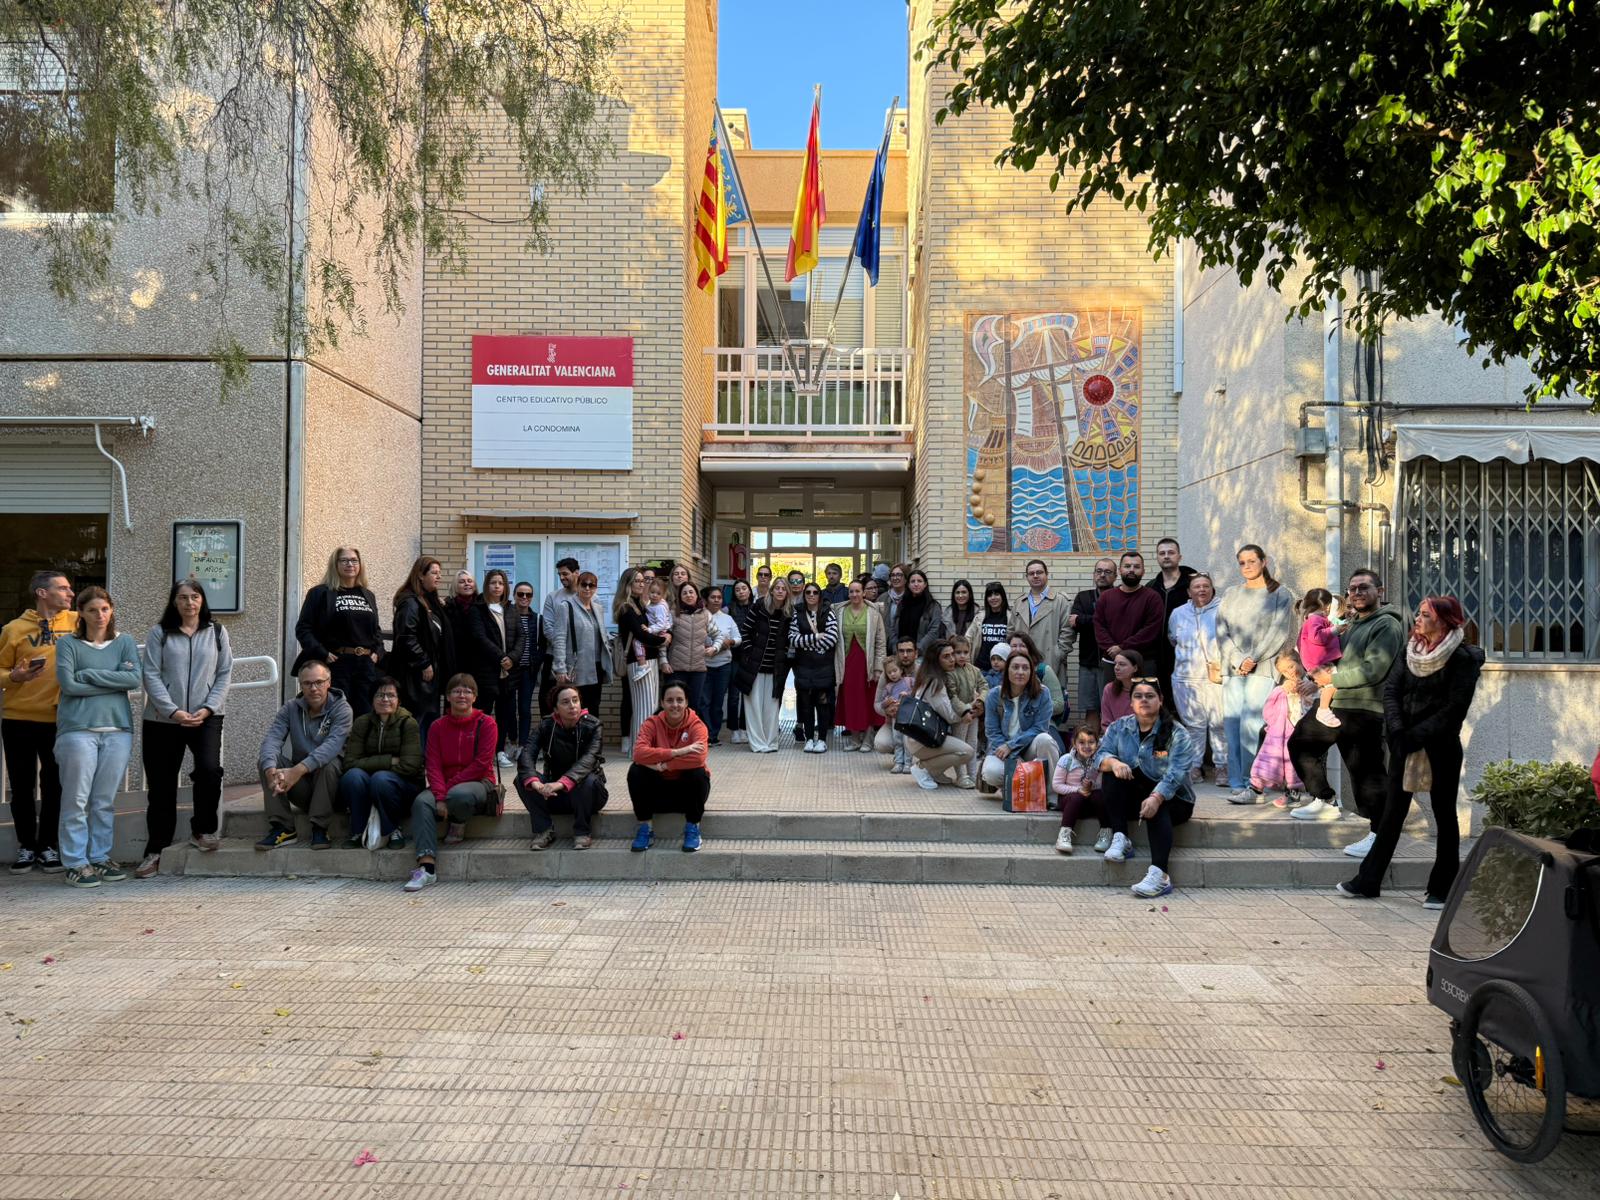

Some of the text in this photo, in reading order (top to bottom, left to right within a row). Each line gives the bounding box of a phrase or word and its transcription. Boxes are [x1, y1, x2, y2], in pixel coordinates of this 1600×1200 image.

[487, 364, 616, 377] GENERALITAT VALENCIANA
[530, 396, 573, 404] EDUCATIVO
[575, 395, 608, 405] PÚBLICO
[194, 556, 226, 564] INFANTIL
[204, 565, 223, 573] AÑOS
[982, 627, 1006, 635] ÚBLIC
